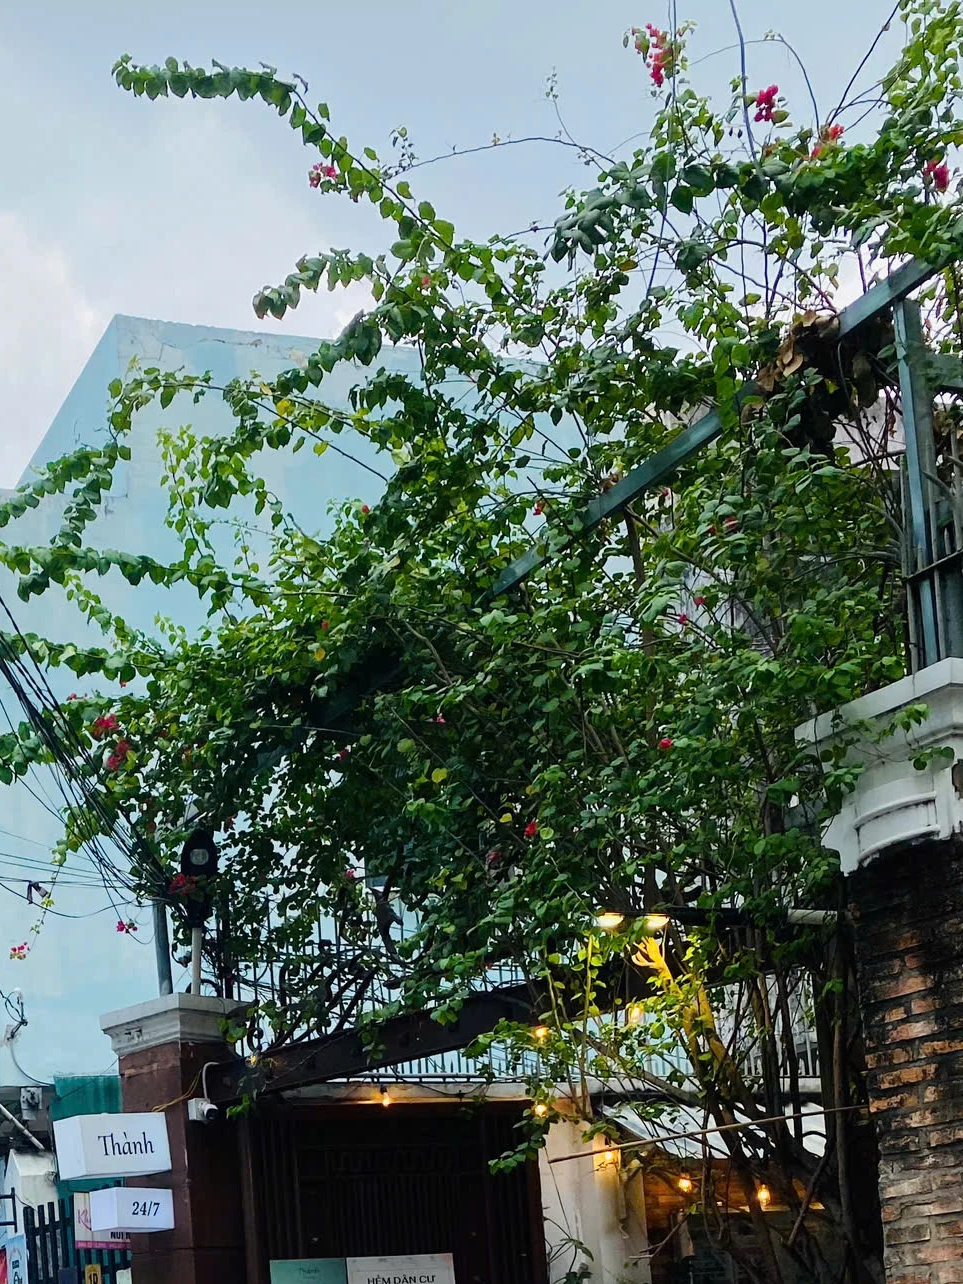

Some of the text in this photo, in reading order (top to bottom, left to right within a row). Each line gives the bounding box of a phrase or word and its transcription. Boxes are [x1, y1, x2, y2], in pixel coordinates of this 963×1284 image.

[98, 1131, 155, 1156] Thành
[132, 1201, 161, 1216] 24/7
[393, 1273, 417, 1284] DÂN
[419, 1274, 437, 1284] CƯ
